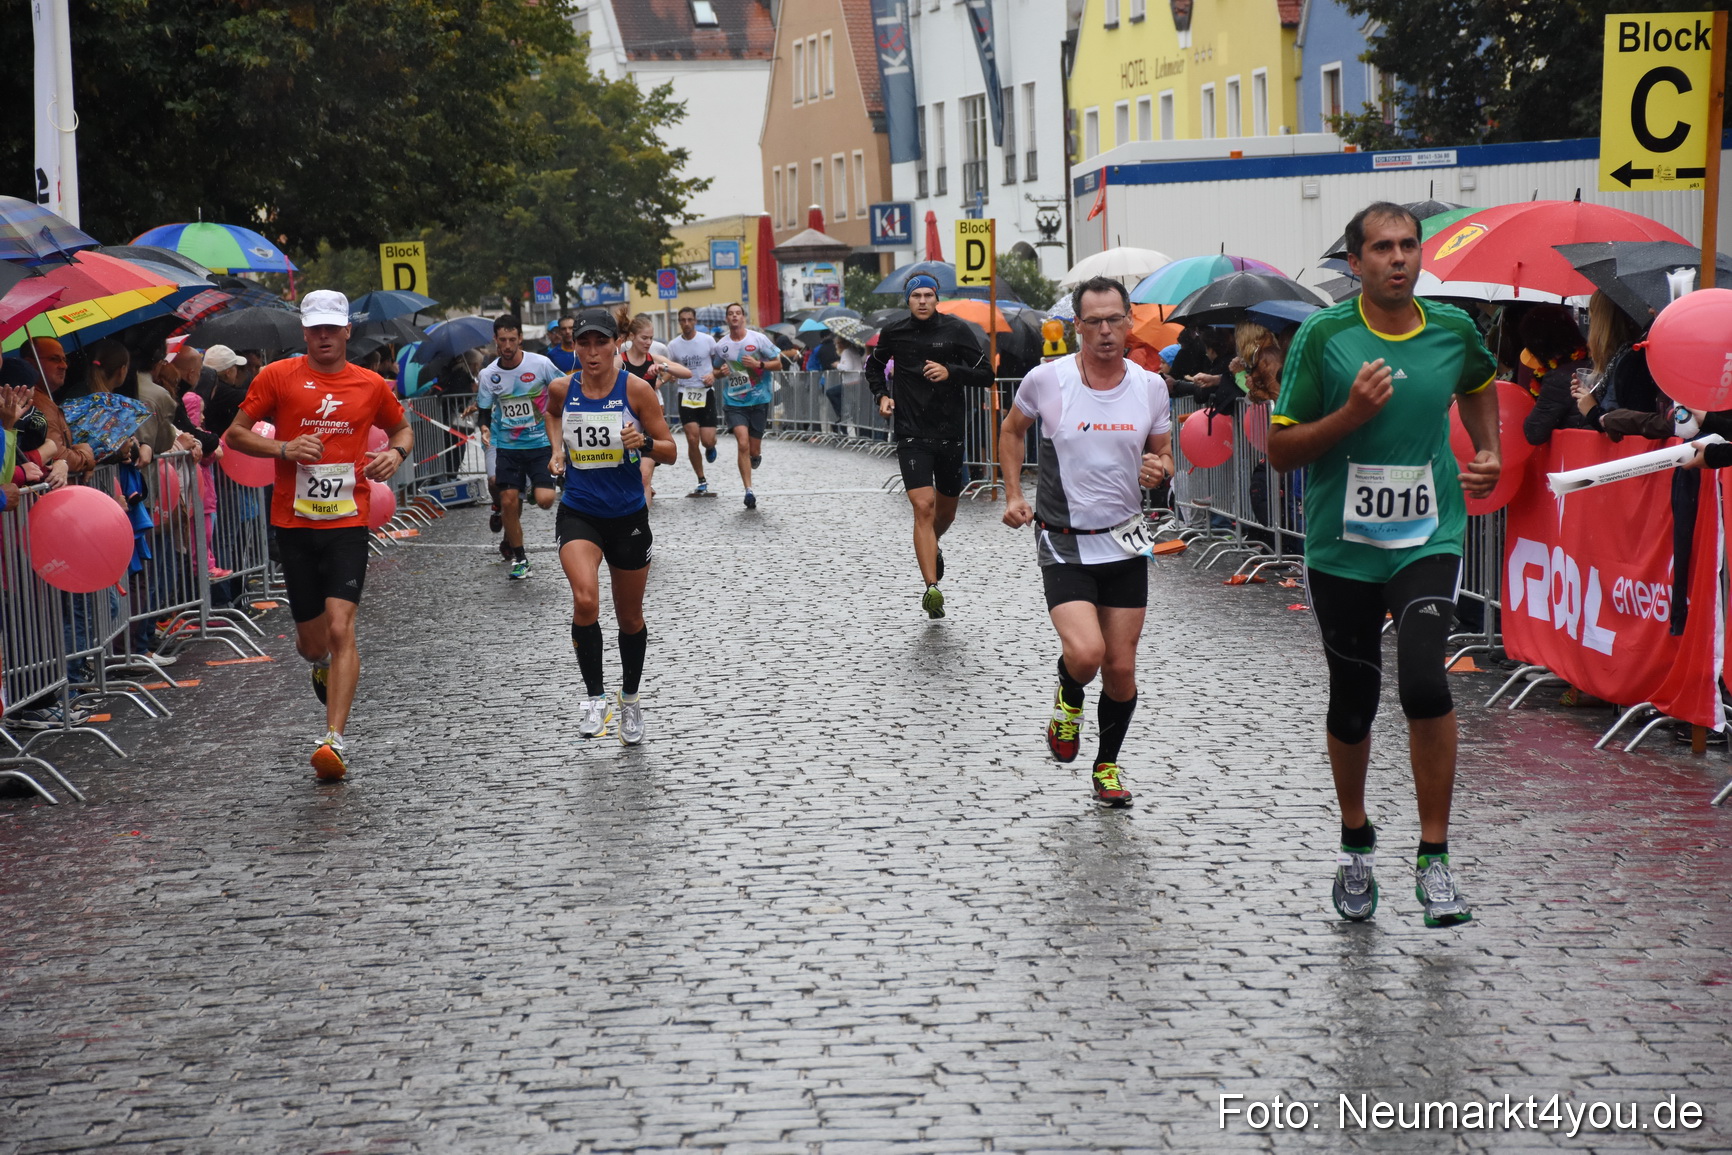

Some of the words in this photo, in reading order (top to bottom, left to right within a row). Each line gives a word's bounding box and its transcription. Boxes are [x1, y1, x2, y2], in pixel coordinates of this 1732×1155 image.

[1619, 20, 1712, 52] Block
[1120, 58, 1148, 89] HOTEL
[1630, 66, 1692, 153] C
[960, 222, 991, 234] Block
[386, 245, 420, 258] Block
[966, 239, 985, 271] D
[393, 262, 416, 292] D
[659, 289, 676, 297] TAXI
[687, 391, 702, 400] 272
[502, 402, 530, 418] 2320
[300, 418, 349, 427] funrunners
[314, 426, 354, 434] neumarkt
[1093, 423, 1137, 432] KLEBL
[573, 426, 611, 448] 133
[308, 477, 344, 499] 297
[312, 503, 339, 514] Harald
[1355, 484, 1430, 518] 3016
